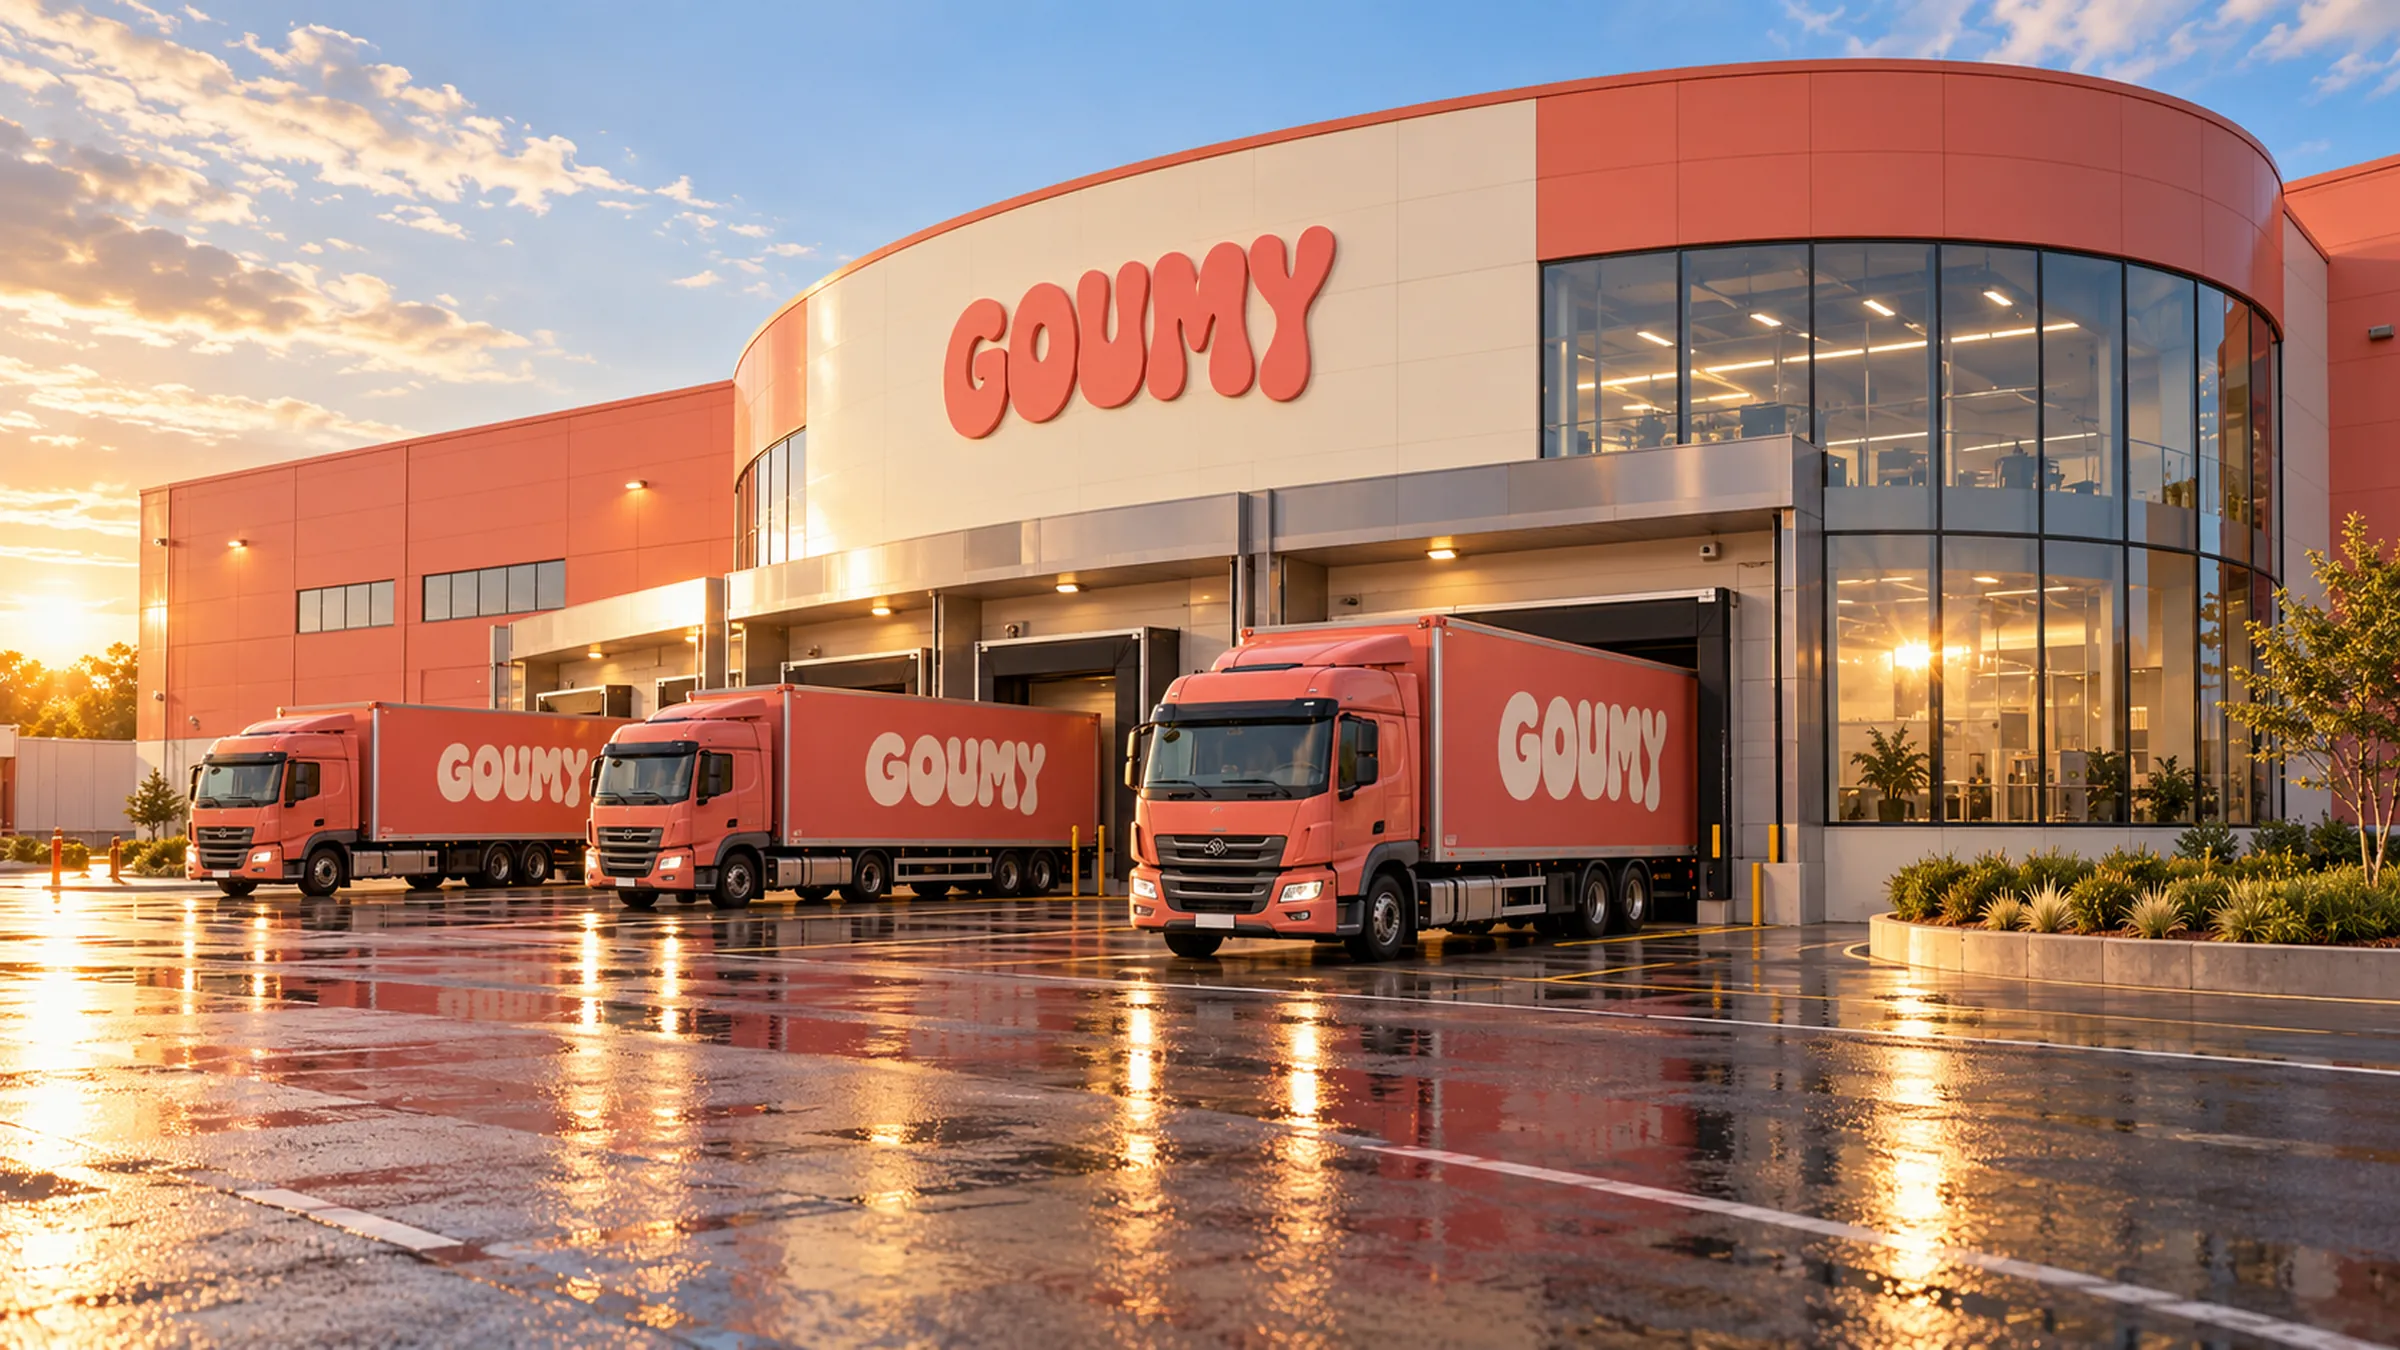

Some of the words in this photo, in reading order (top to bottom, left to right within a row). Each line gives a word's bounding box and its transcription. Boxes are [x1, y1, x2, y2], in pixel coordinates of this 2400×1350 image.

[943, 225, 1337, 440] GOUMY
[437, 743, 589, 808] GOUMY
[865, 732, 1046, 816] GOUMY
[1497, 691, 1667, 812] GOUMY
